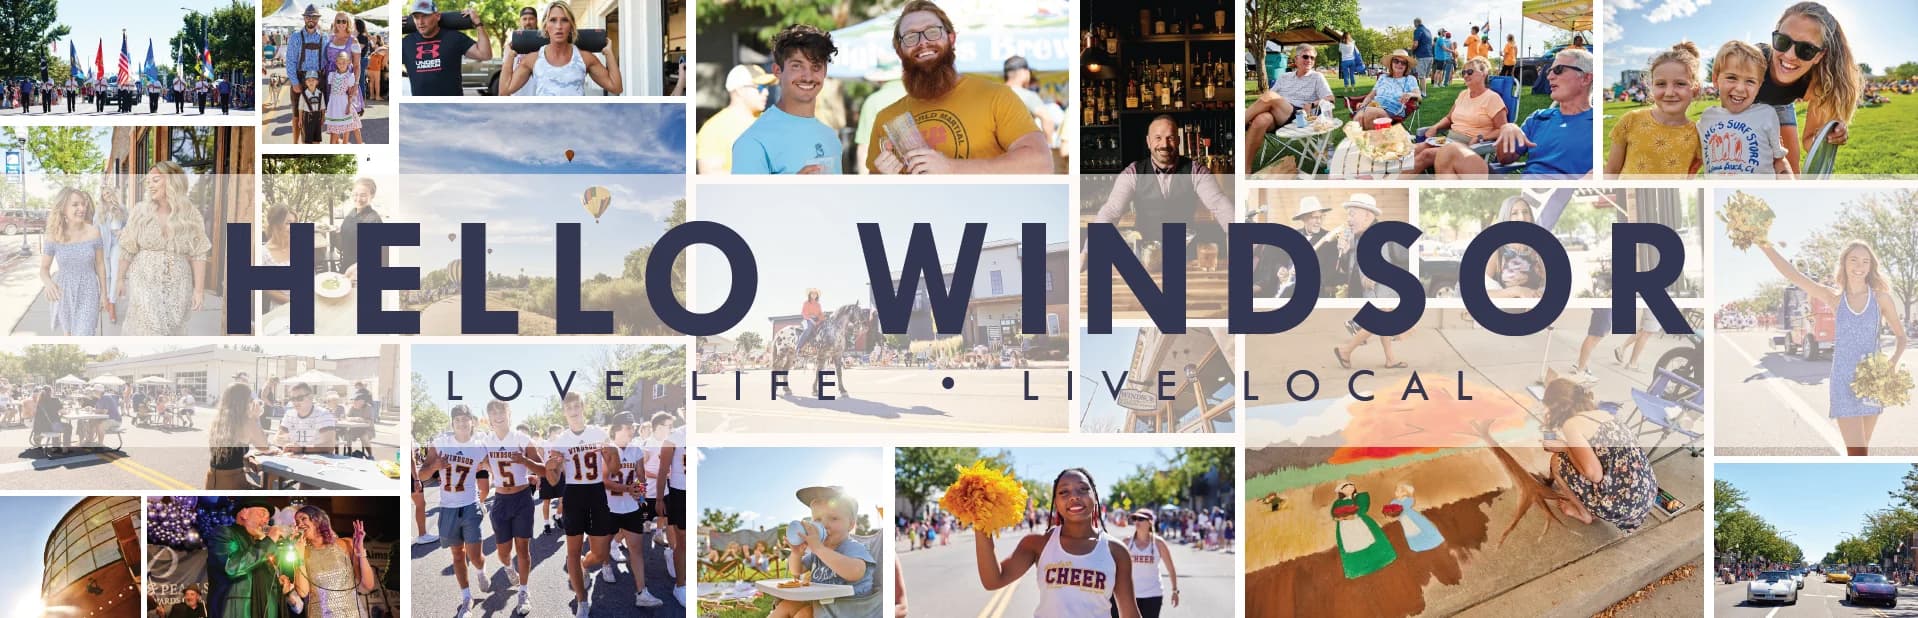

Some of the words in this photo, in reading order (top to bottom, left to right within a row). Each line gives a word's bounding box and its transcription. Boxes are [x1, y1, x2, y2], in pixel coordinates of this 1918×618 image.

[1726, 119, 1752, 135] SURF
[1746, 132, 1760, 167] STORE
[489, 451, 514, 459] WINDSO
[572, 450, 599, 481] 19
[443, 463, 471, 492] 17
[497, 460, 515, 488] 5
[1045, 567, 1106, 590] CHEER
